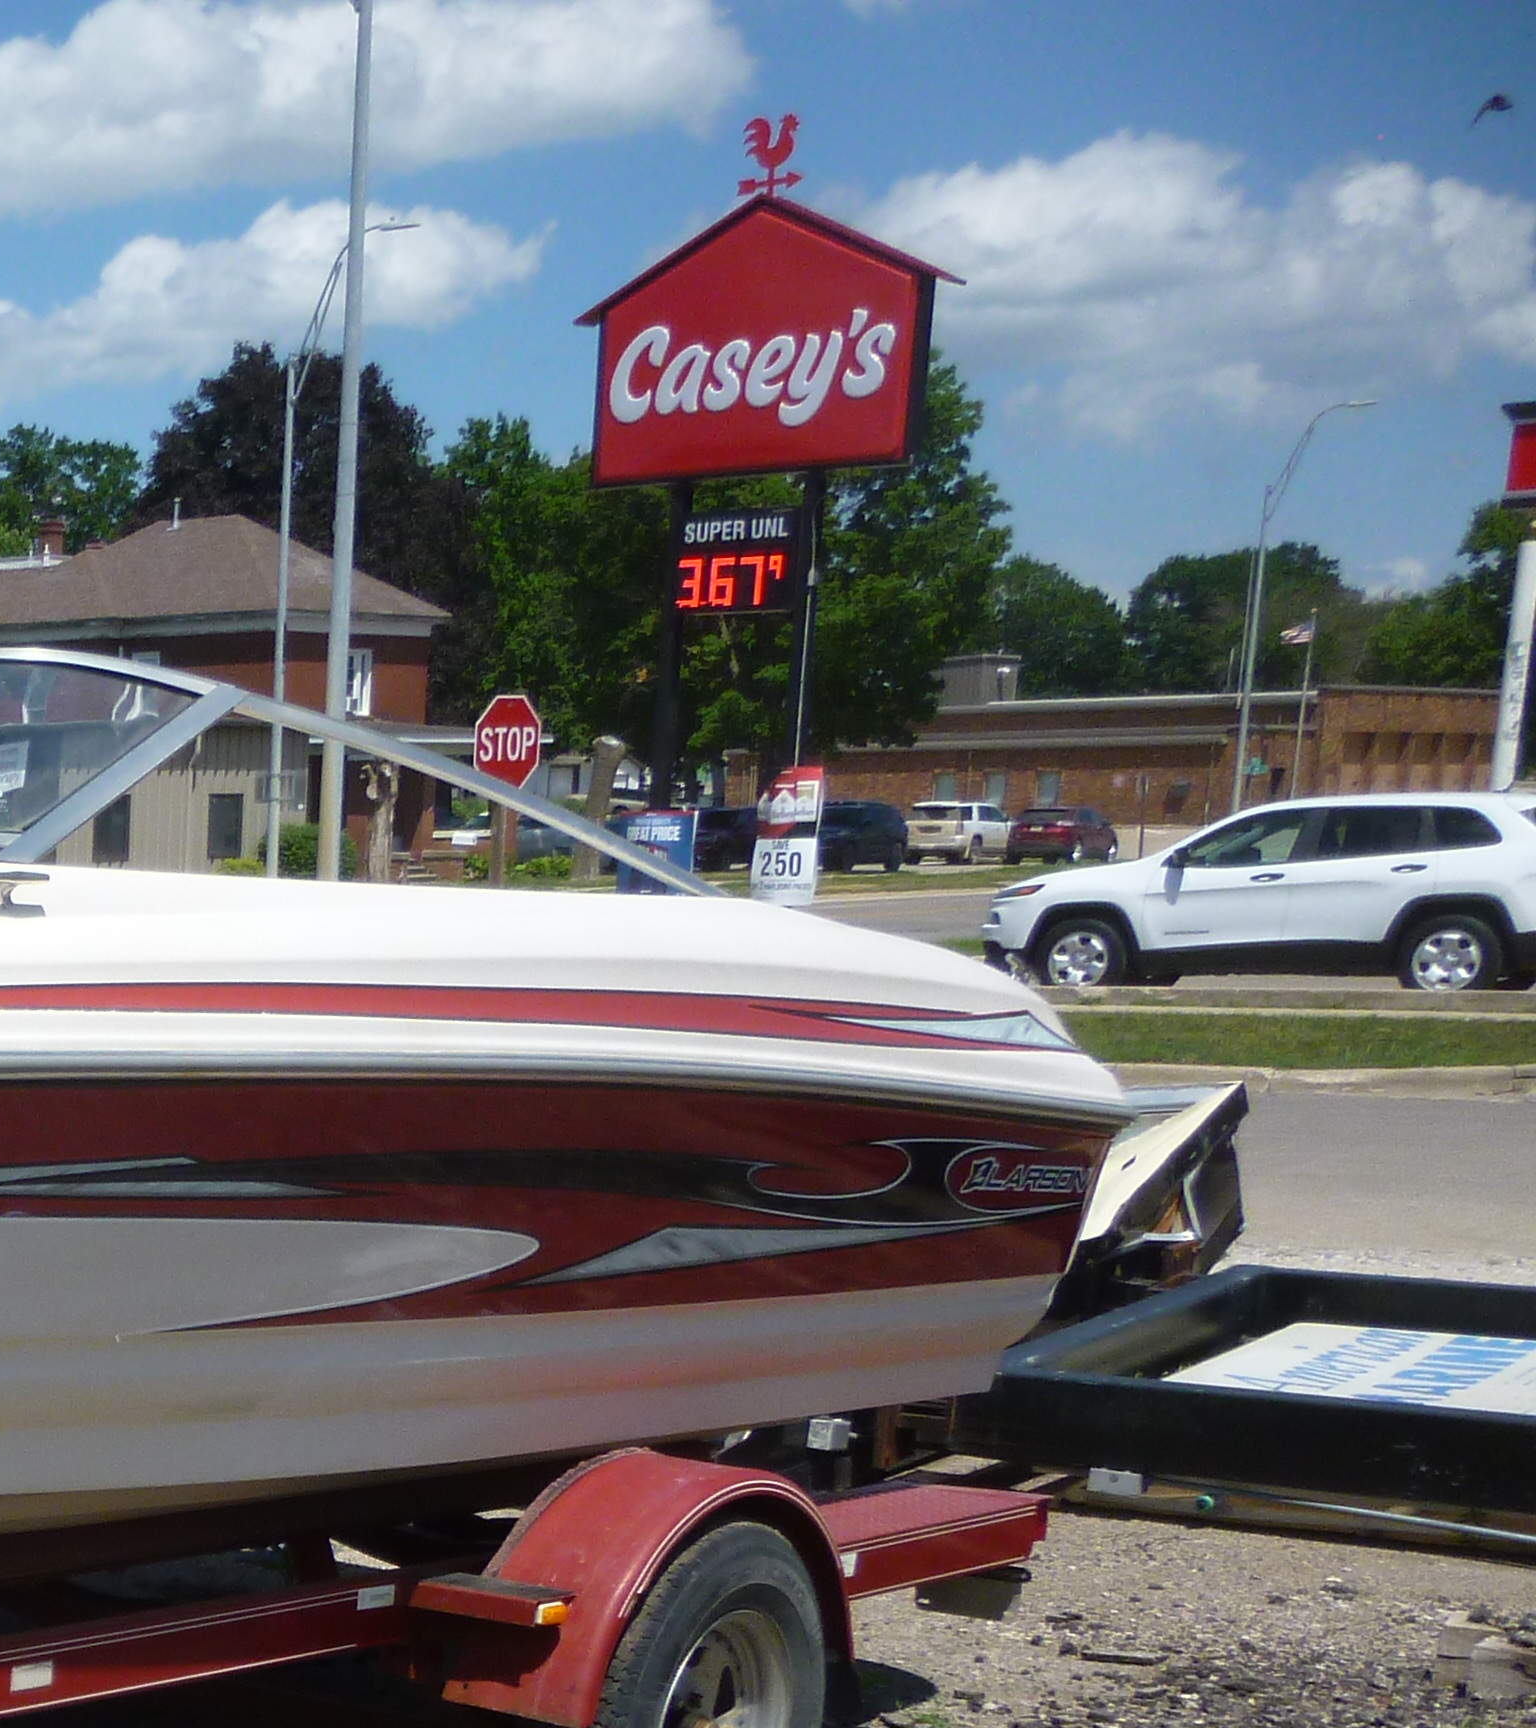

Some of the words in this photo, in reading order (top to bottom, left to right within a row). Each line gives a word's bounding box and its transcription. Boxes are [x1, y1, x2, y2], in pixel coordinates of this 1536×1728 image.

[609, 309, 896, 427] Casey's
[684, 520, 745, 544] SUPER
[751, 517, 788, 539] UNL
[479, 727, 536, 762] STOP
[651, 826, 681, 842] PRICE
